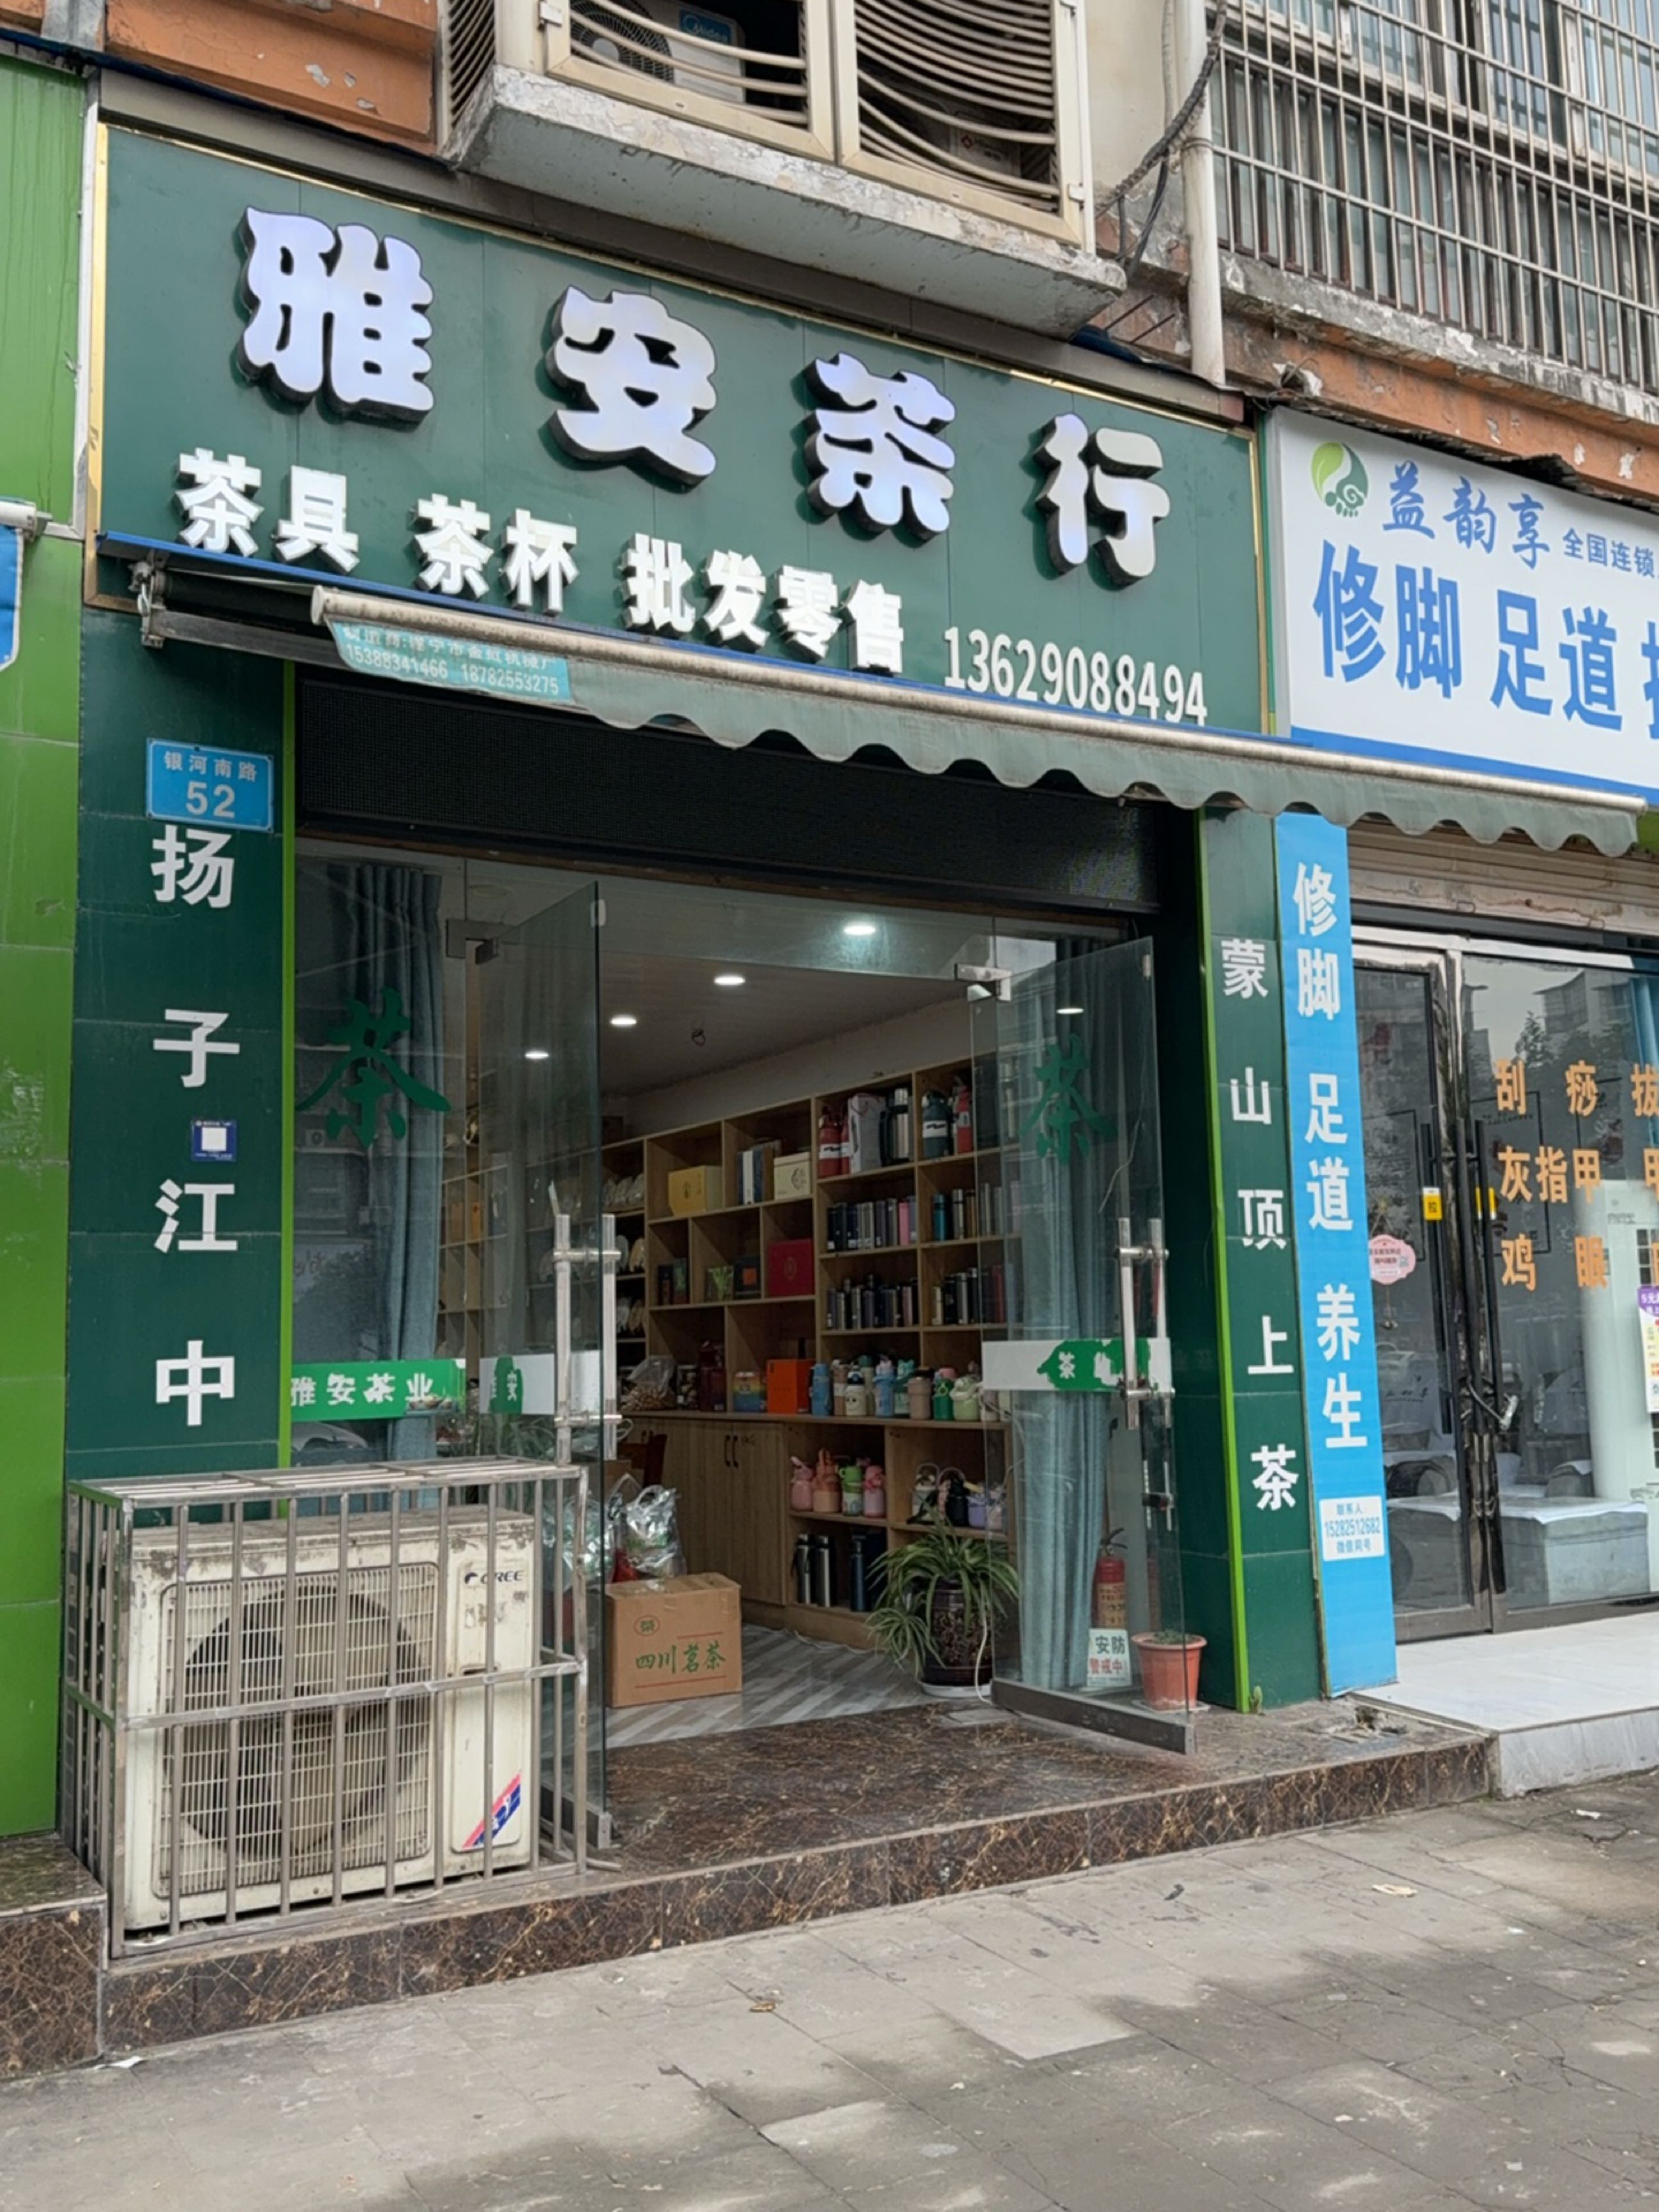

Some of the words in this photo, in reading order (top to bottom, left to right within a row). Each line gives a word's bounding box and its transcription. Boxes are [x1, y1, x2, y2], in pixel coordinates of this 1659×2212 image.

[238, 206, 1171, 586] 雅安茶行
[176, 448, 359, 573] 茶具
[413, 494, 579, 614] 茶杯
[622, 533, 904, 676] 批发零售
[1382, 460, 1550, 569] 益韵享
[1562, 527, 1655, 578] 全国连锁
[461, 664, 559, 696] 18782553275
[944, 626, 1208, 726] 13629088494
[1313, 540, 1463, 699] 修脚
[1490, 589, 1623, 731] 足道
[164, 750, 257, 782] 银河南路
[185, 781, 236, 819] 52
[1293, 862, 1341, 1020] 修脚
[150, 824, 240, 1427] 扬子江中
[1498, 1145, 1601, 1204] 灰指甲
[1221, 938, 1299, 1511] 蒙山顶上茶
[636, 1640, 726, 1675] 四川茗茶
[1095, 1635, 1125, 1655] 安防
